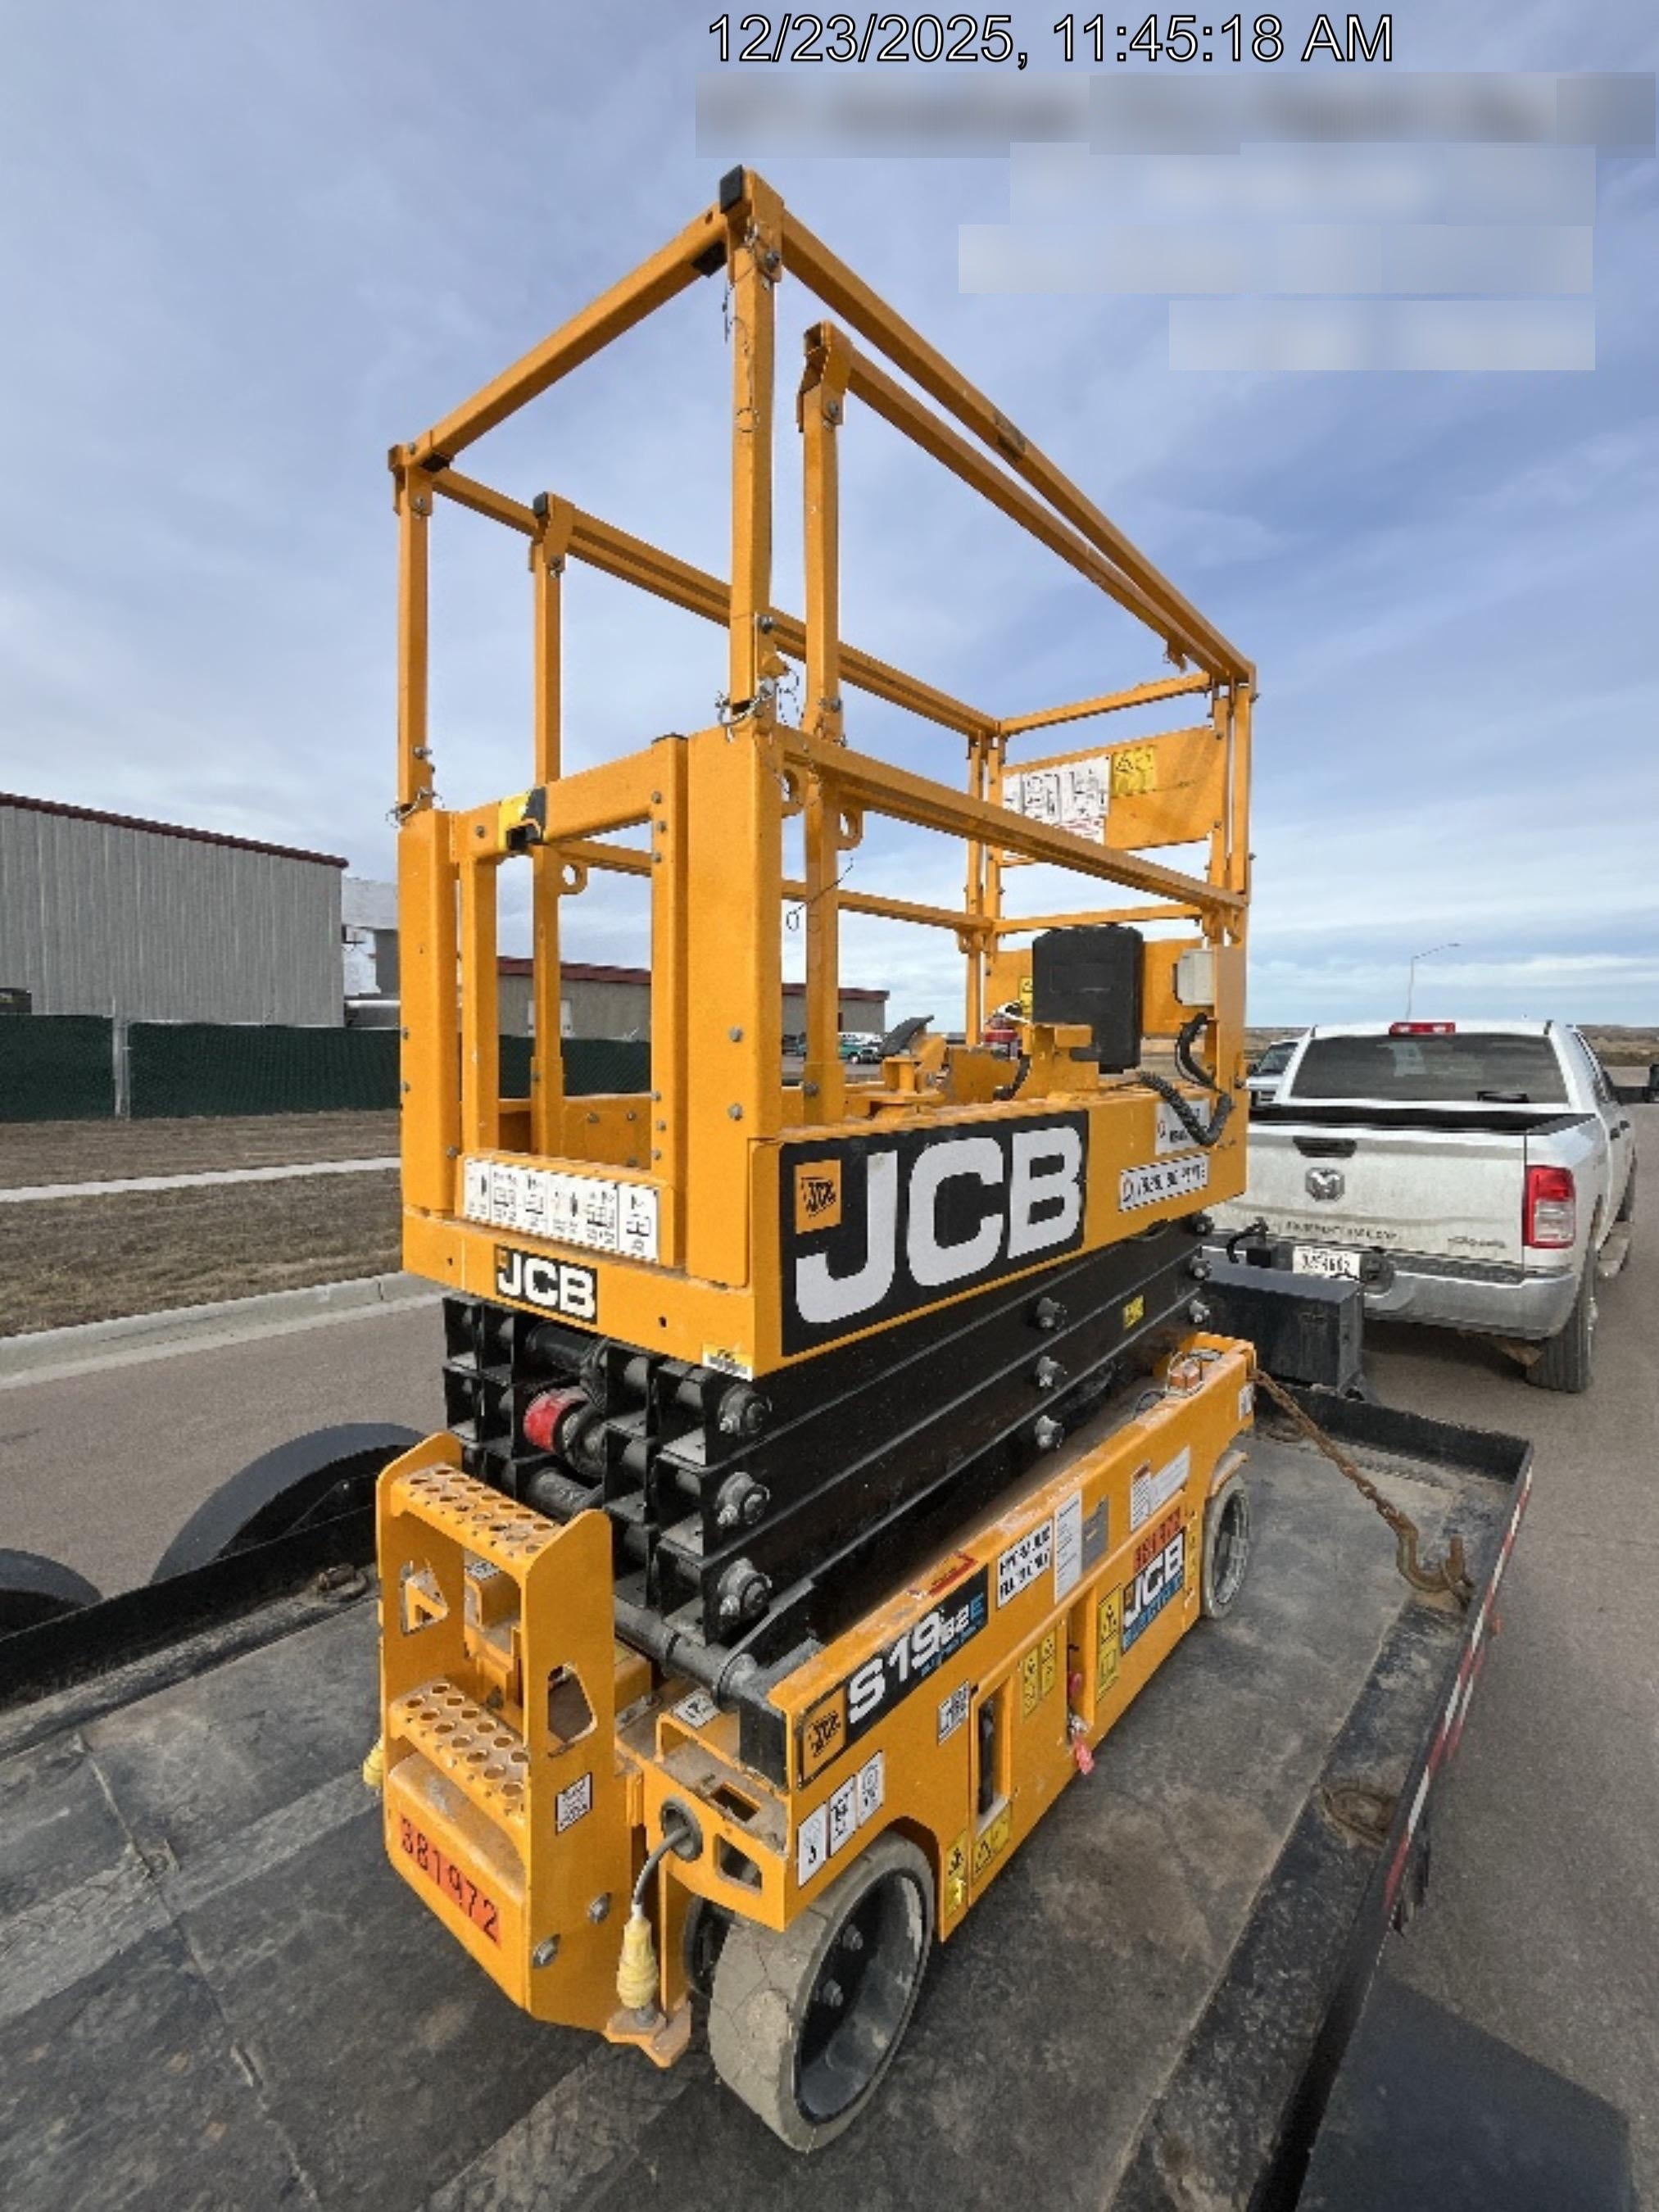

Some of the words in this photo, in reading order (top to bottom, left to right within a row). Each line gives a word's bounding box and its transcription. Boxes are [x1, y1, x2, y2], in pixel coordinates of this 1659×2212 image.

[796, 1126, 1083, 1324] JCB
[497, 1253, 596, 1320] JCB
[1124, 1531, 1185, 1630] JCB
[401, 1816, 498, 1943] 381972
